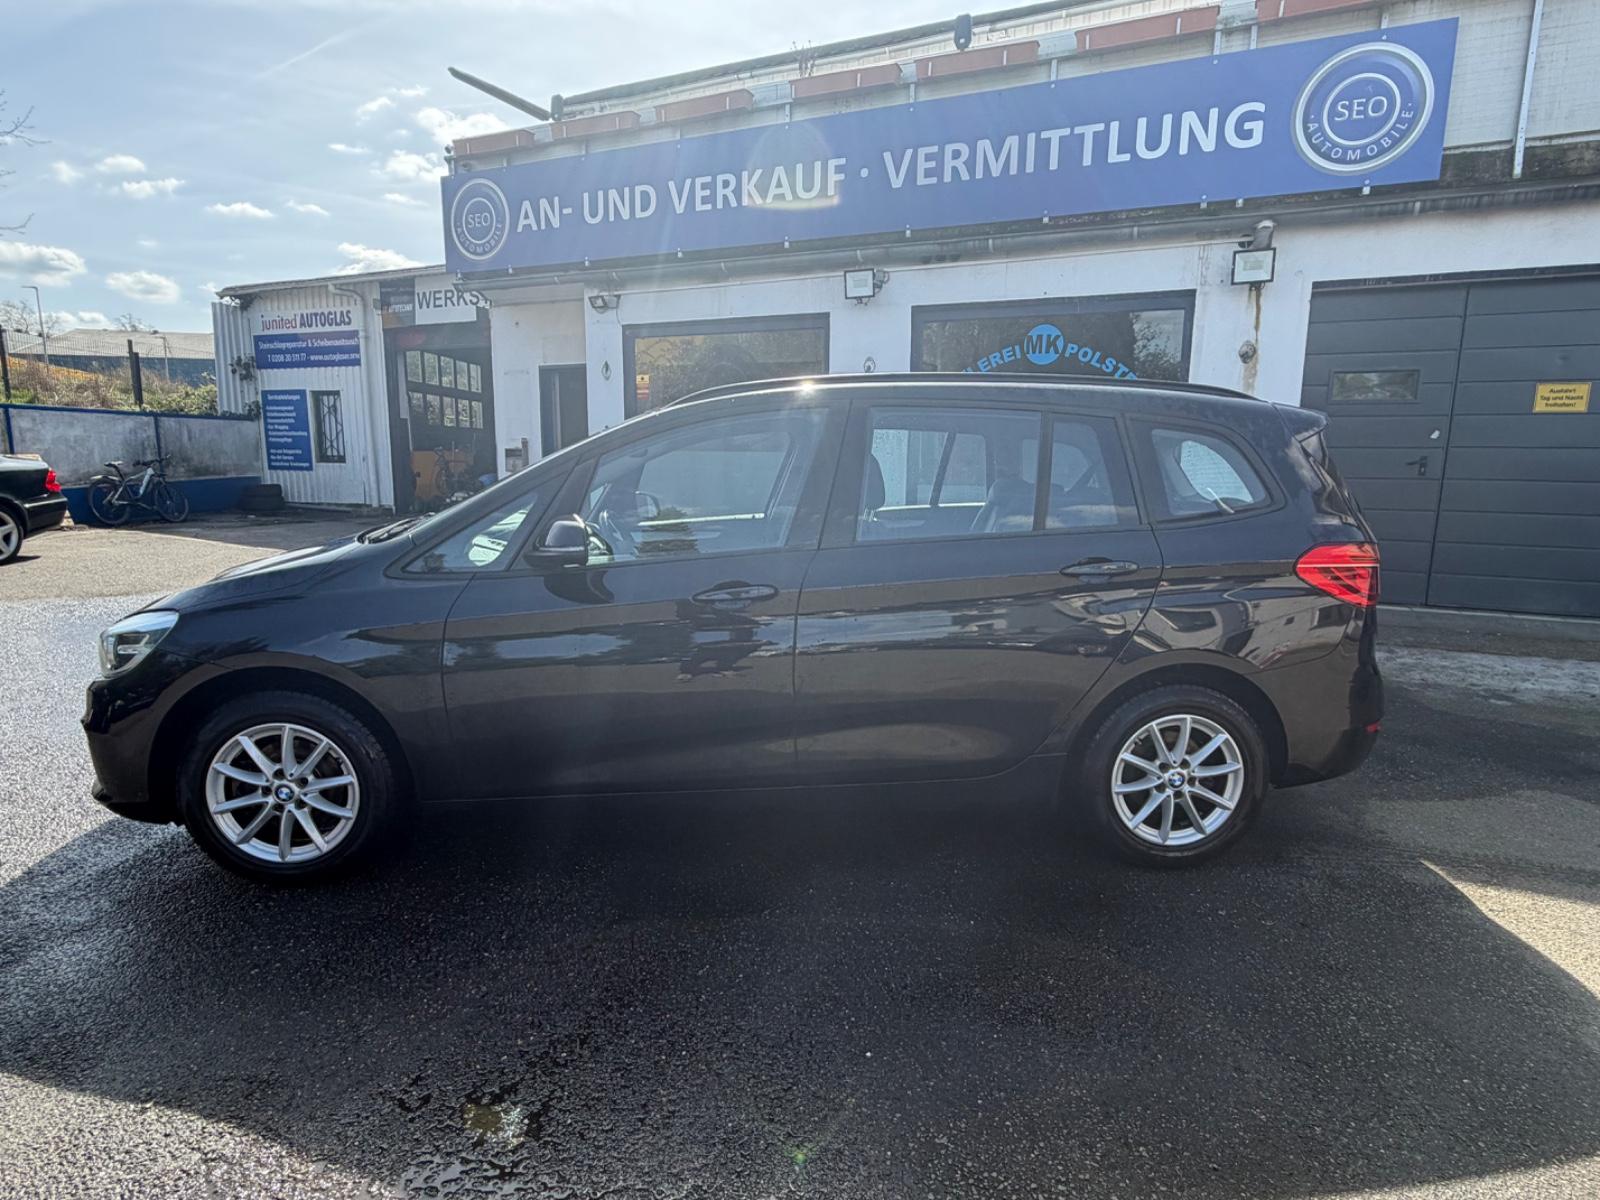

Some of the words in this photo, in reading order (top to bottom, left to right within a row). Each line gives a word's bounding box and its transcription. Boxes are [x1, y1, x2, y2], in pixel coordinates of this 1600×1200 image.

[1334, 96, 1388, 121] SEO
[1307, 109, 1414, 161] AUTOMOBILE
[516, 195, 573, 233] AN-
[582, 184, 657, 224] UND
[668, 157, 847, 214] VERKAUF
[882, 101, 1266, 189] VERMITTLUNG
[468, 212, 490, 228] SEO
[261, 314, 297, 331] junited
[299, 310, 352, 329] AUTOGLAS
[1024, 333, 1064, 355] MK
